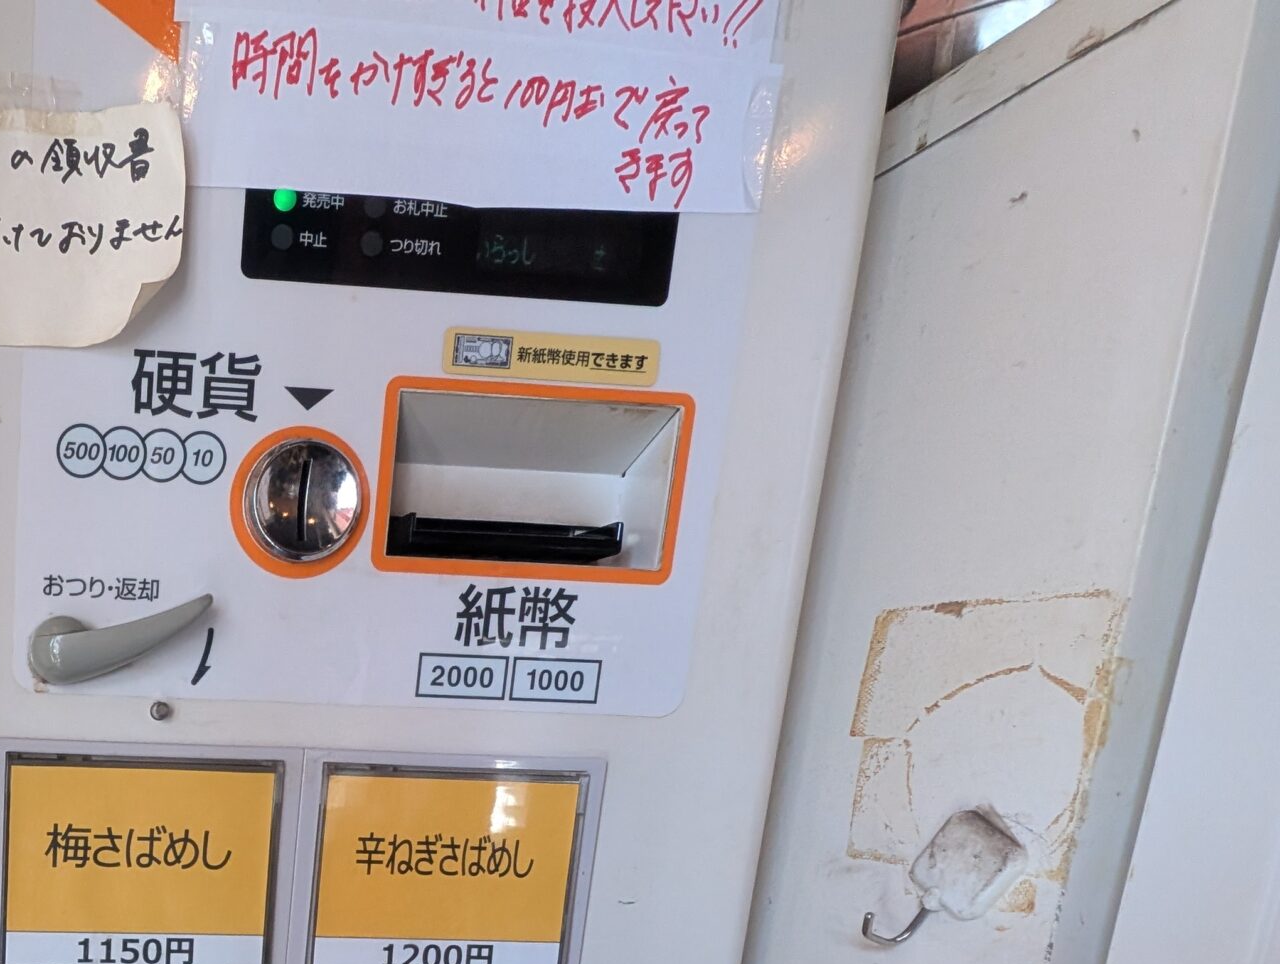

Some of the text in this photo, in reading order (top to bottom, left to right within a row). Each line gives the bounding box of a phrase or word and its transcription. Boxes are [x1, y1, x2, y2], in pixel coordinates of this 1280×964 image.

[616, 147, 694, 209] きます
[302, 191, 345, 210] 発売中
[393, 199, 448, 218] お札中止
[299, 231, 328, 249] 中止
[390, 238, 442, 256] つり切れ
[517, 346, 649, 371] 新紙幣使用できます
[130, 348, 263, 423] 硬貨
[63, 440, 214, 471] 500 100 50 10
[42, 574, 160, 602] おつり・返却
[454, 584, 579, 650] 紙幣
[429, 664, 585, 693] 2000 1000
[45, 823, 232, 870] 梅さばめし
[355, 831, 535, 879] 辛ねぎさばめし
